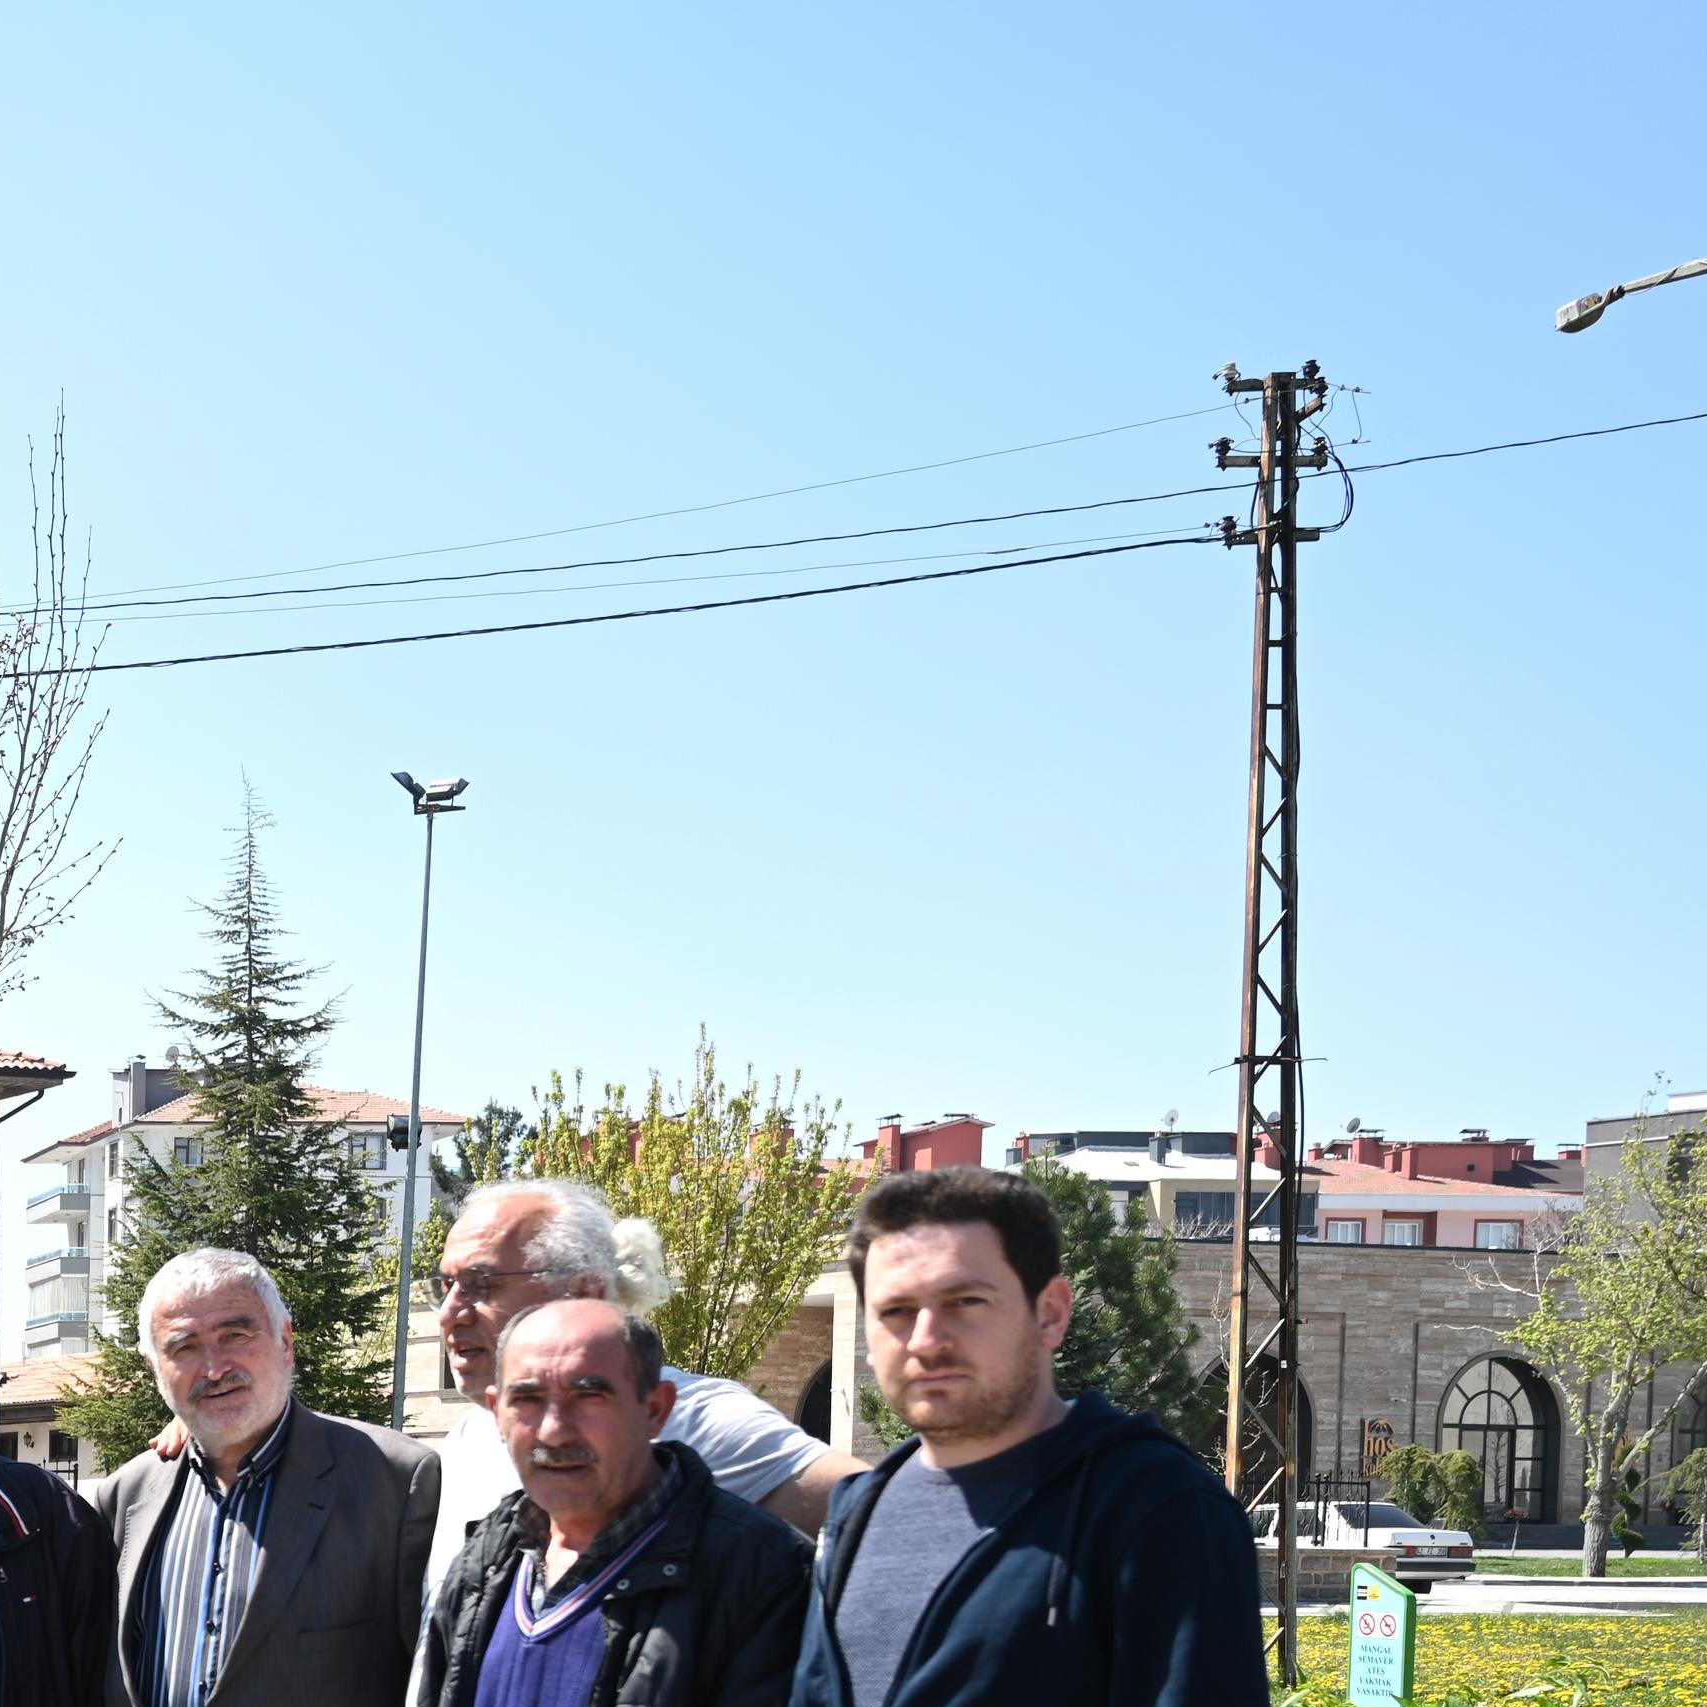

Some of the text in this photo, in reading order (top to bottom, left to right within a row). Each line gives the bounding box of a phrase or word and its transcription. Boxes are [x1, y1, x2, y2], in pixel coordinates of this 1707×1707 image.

[1360, 1645, 1392, 1655] MANGAL
[1358, 1656, 1393, 1665] SEMAVER
[1367, 1667, 1385, 1676] ATEŞ
[1359, 1677, 1392, 1687] YAKMAK
